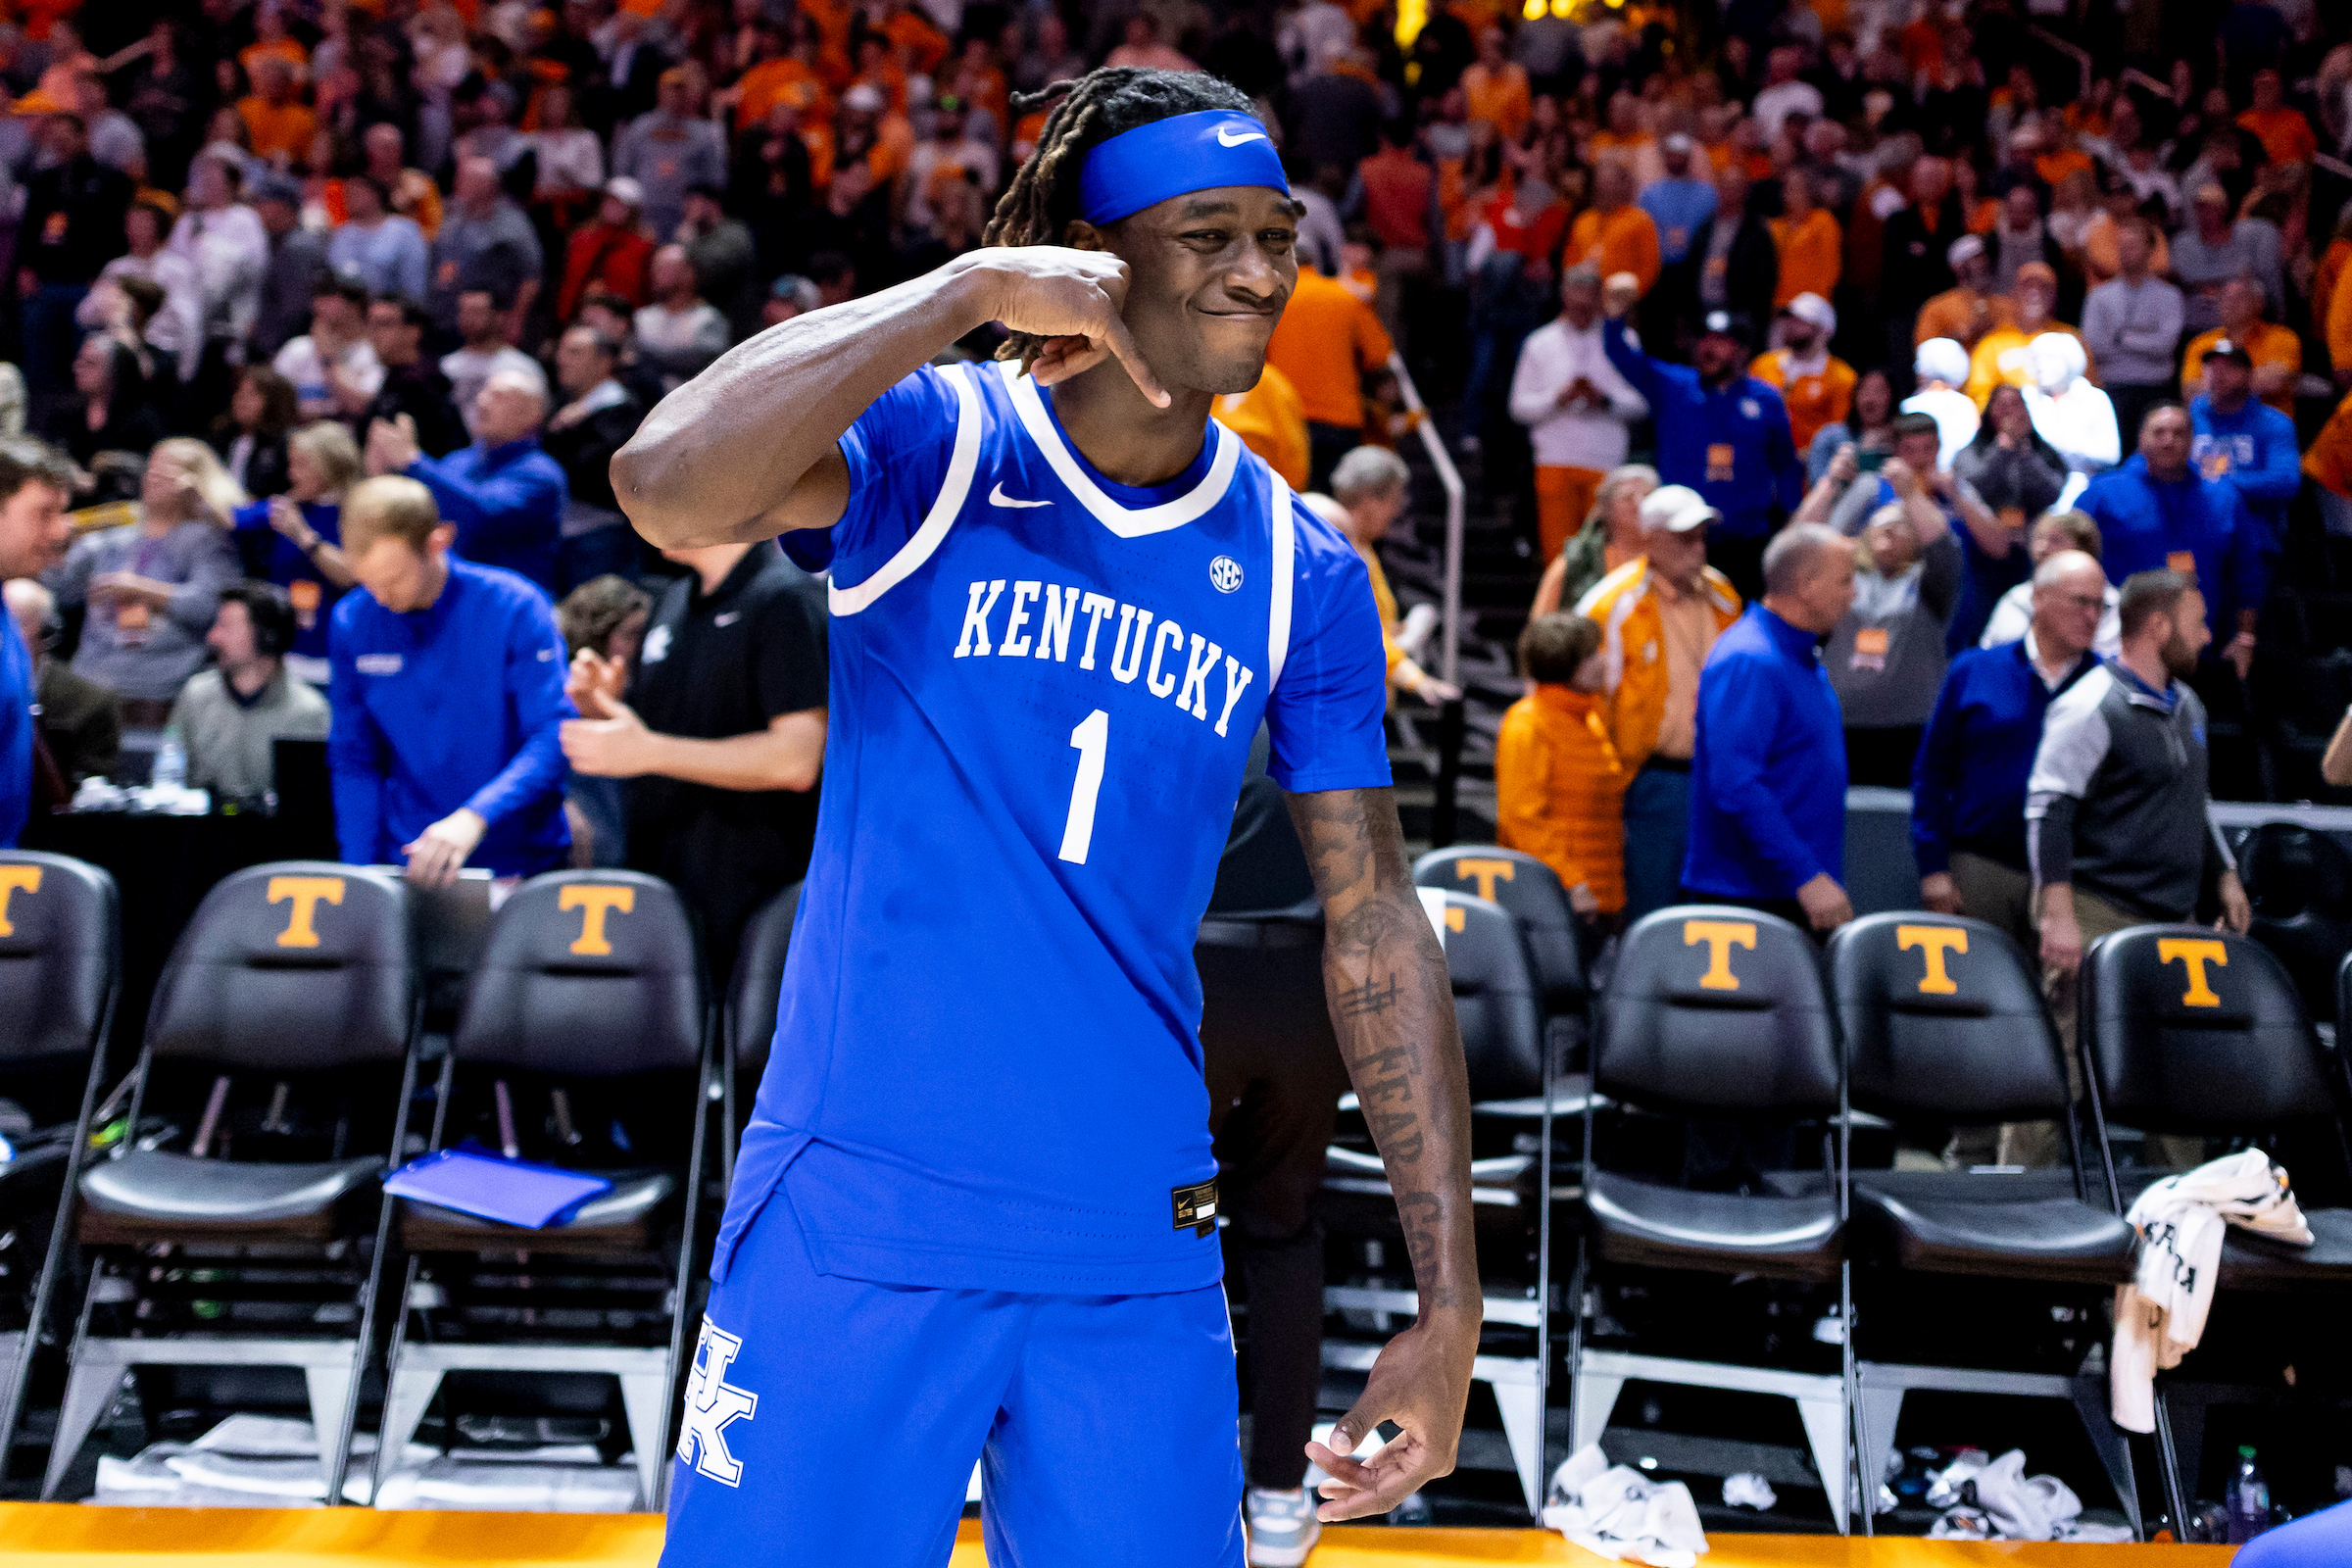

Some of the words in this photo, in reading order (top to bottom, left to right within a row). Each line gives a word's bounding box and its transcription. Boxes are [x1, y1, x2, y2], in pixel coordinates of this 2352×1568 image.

[1212, 557, 1242, 591] SEC
[954, 579, 1253, 738] KENTUCKY
[1057, 709, 1109, 865] 1
[267, 877, 344, 948] T
[1456, 858, 1515, 903] T
[559, 885, 634, 956] T
[1684, 921, 1757, 990] T
[1896, 925, 1969, 995] T
[2157, 938, 2228, 1007] T
